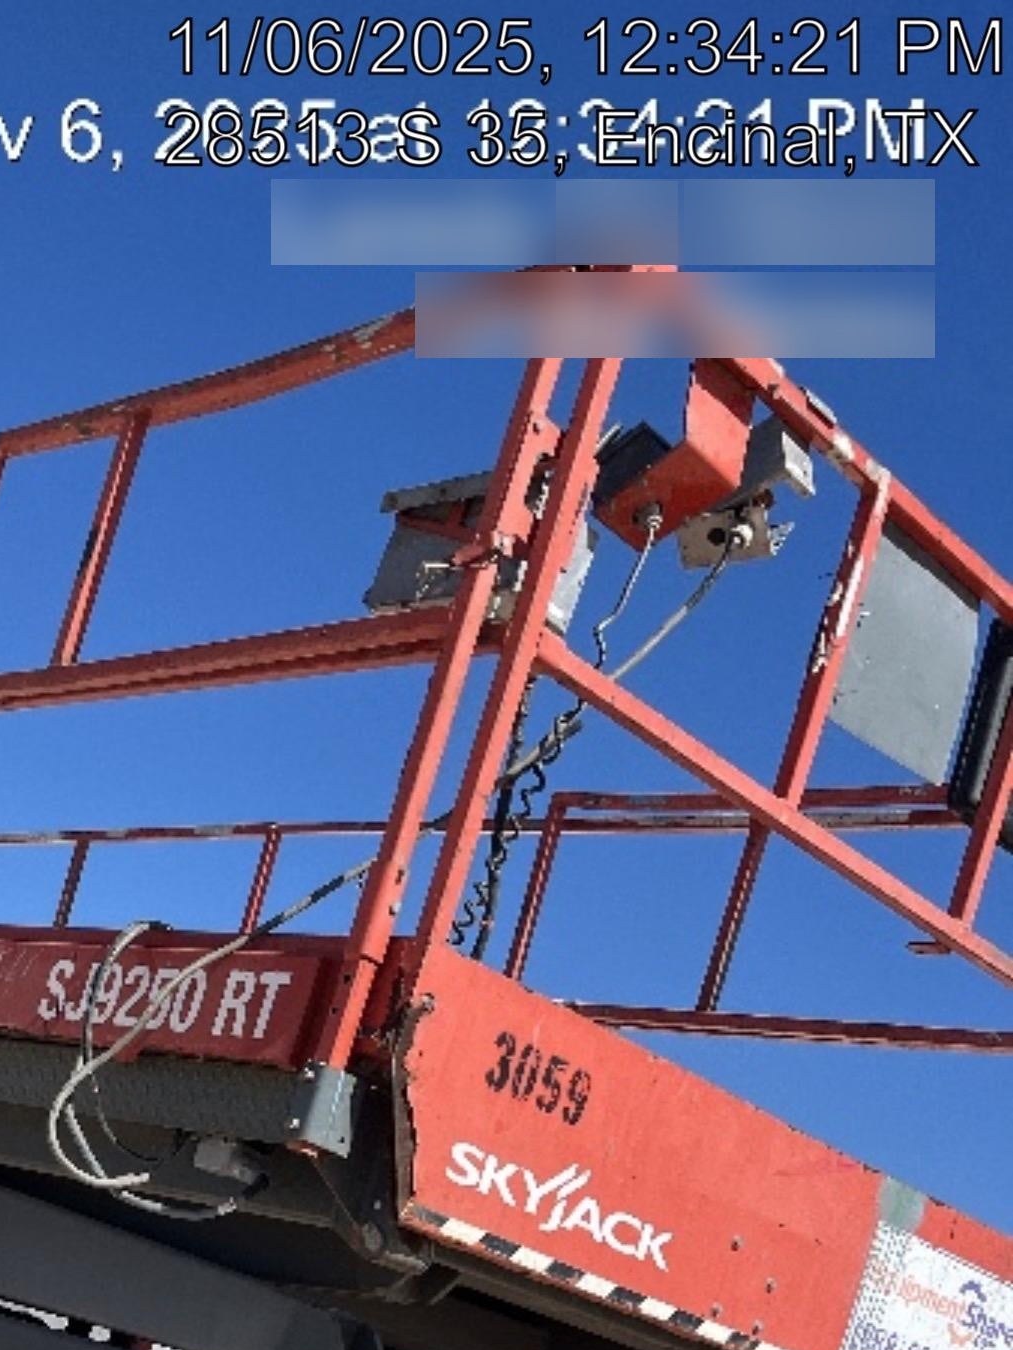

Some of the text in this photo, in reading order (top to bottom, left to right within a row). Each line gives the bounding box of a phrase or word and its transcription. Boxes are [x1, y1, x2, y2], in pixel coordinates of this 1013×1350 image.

[38, 959, 291, 1038] SJ9250 RT
[486, 1031, 591, 1125] 3059
[445, 1142, 672, 1272] SKYJACK
